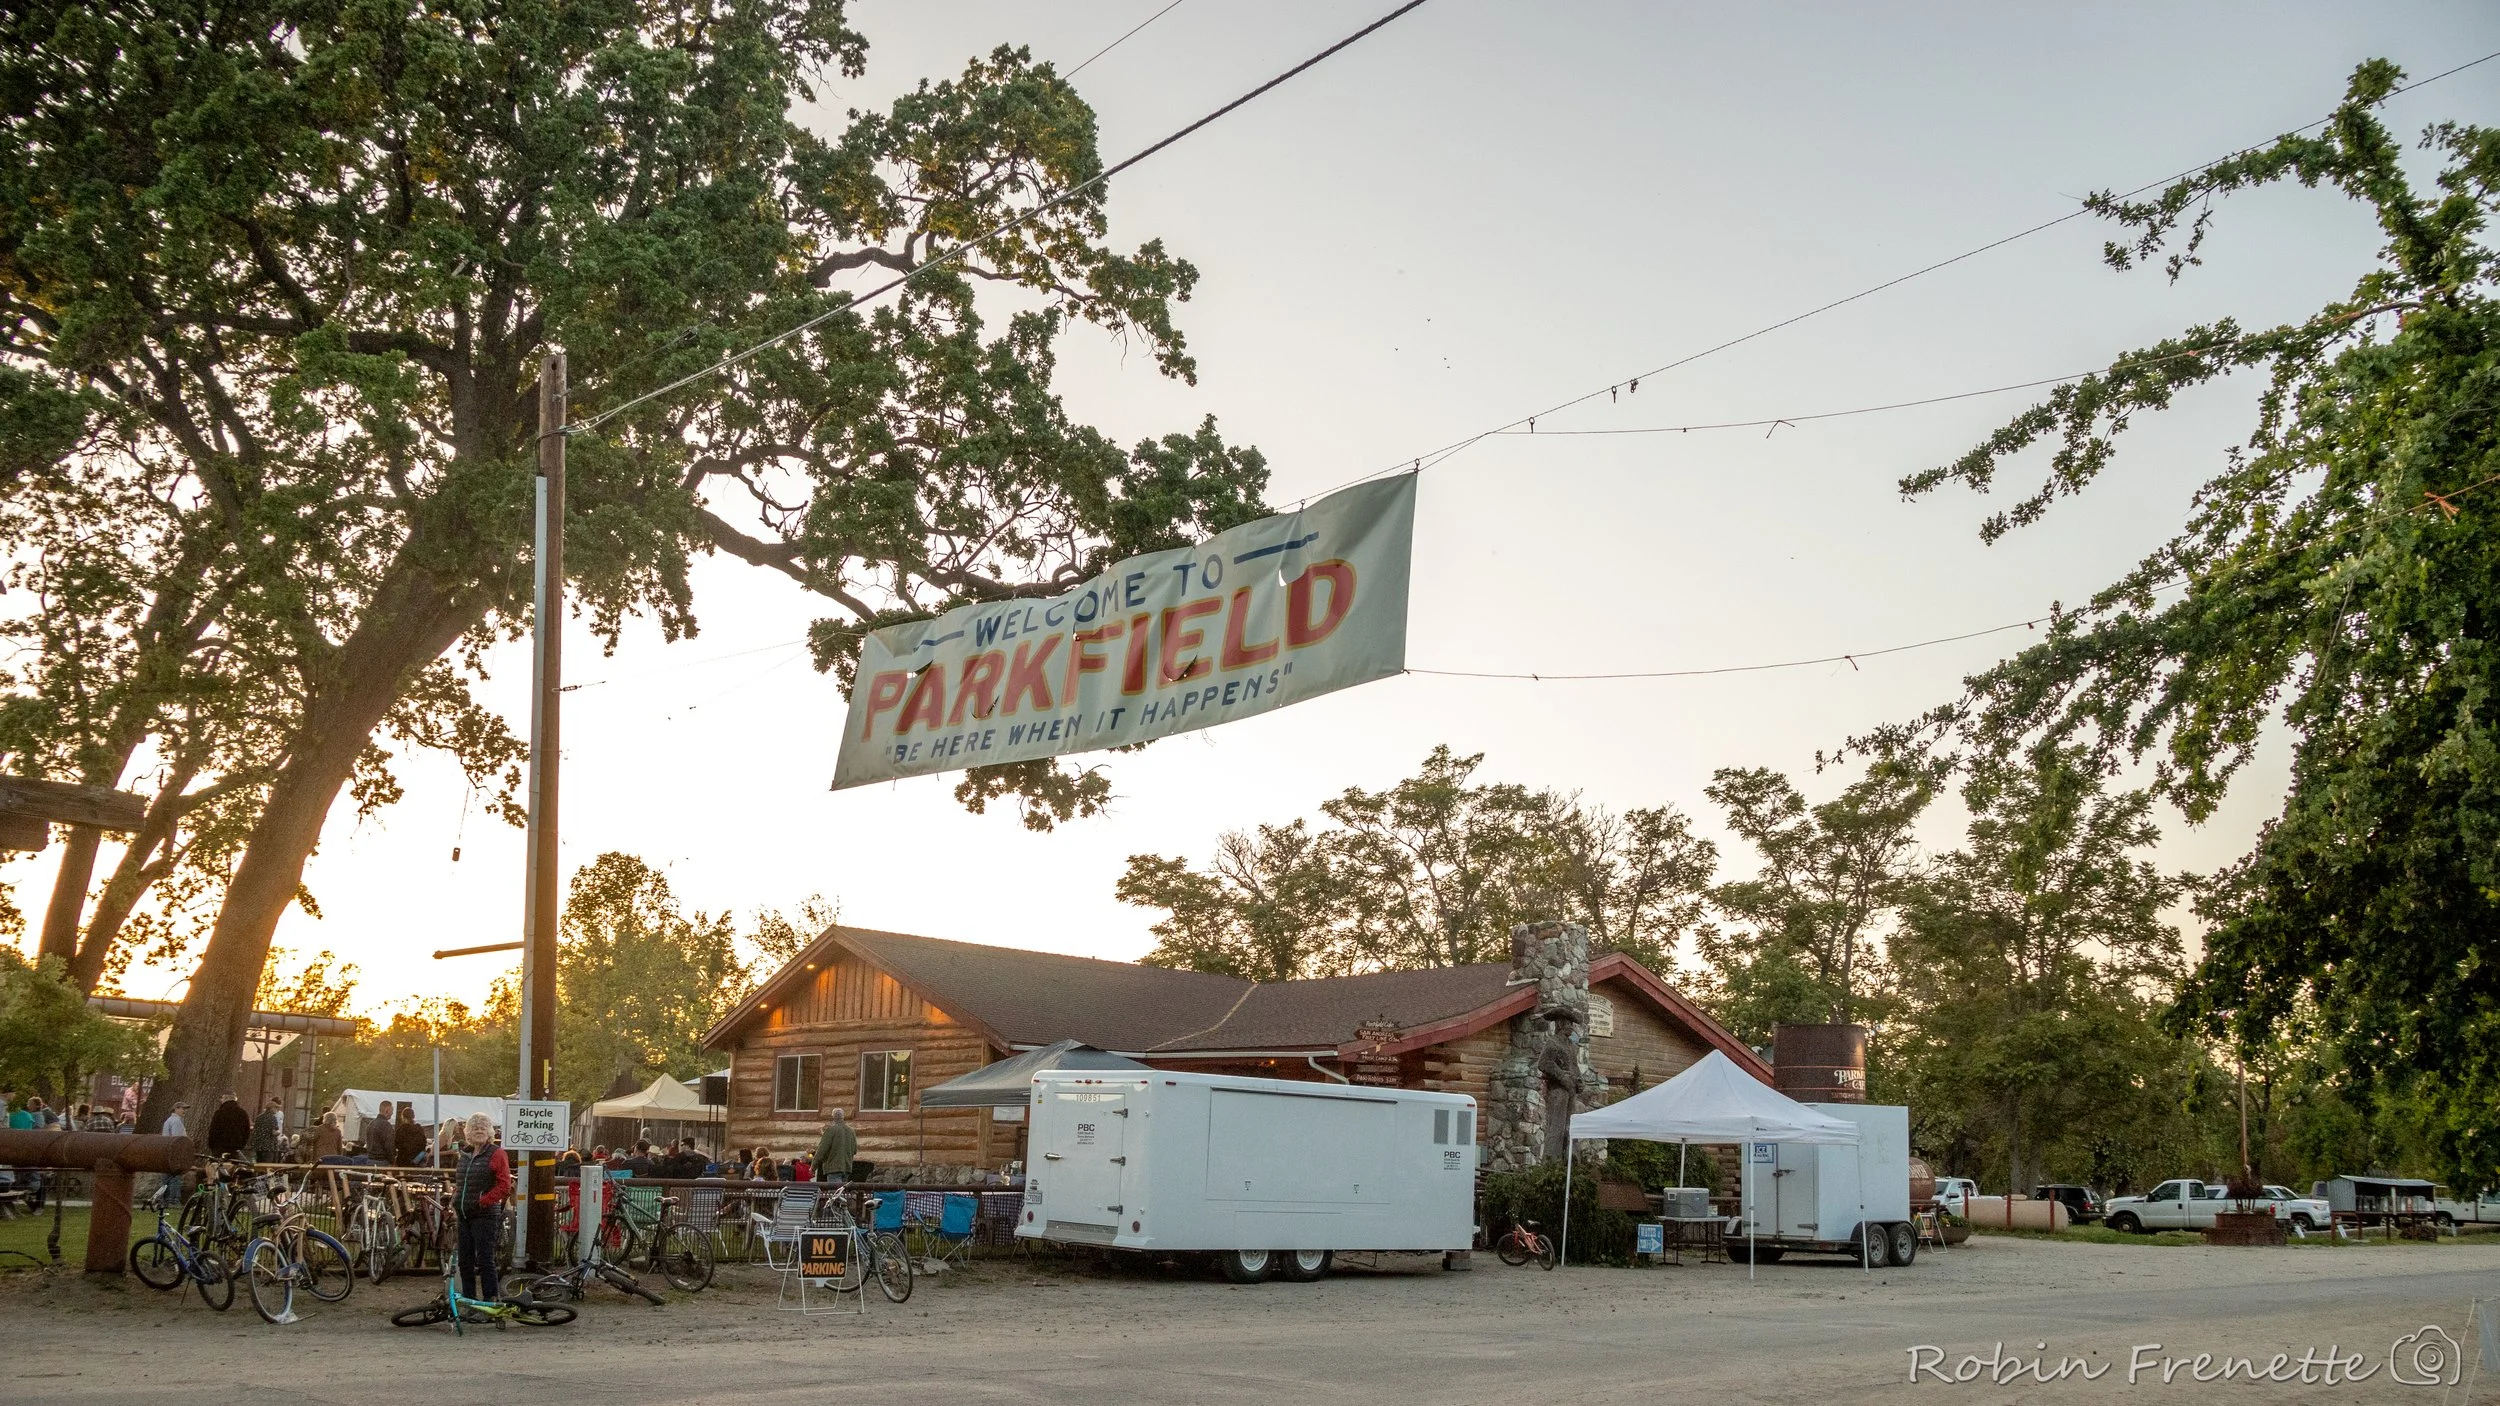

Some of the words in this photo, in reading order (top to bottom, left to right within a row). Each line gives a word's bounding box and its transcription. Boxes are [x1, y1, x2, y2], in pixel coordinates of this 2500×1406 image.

[976, 572, 1146, 647] WELCOME
[1173, 554, 1223, 597] TO
[861, 558, 1357, 743] PARKFIELD
[930, 729, 996, 758] HERE
[1008, 714, 1083, 746] WHEN
[1096, 708, 1126, 733] IT
[1140, 661, 1293, 726] HAPPENS"
[519, 1108, 553, 1118] Bicycle
[517, 1120, 554, 1131] Parking
[1077, 1123, 1095, 1131] PBC
[812, 1238, 836, 1255] NO
[802, 1262, 845, 1275] PARKING
